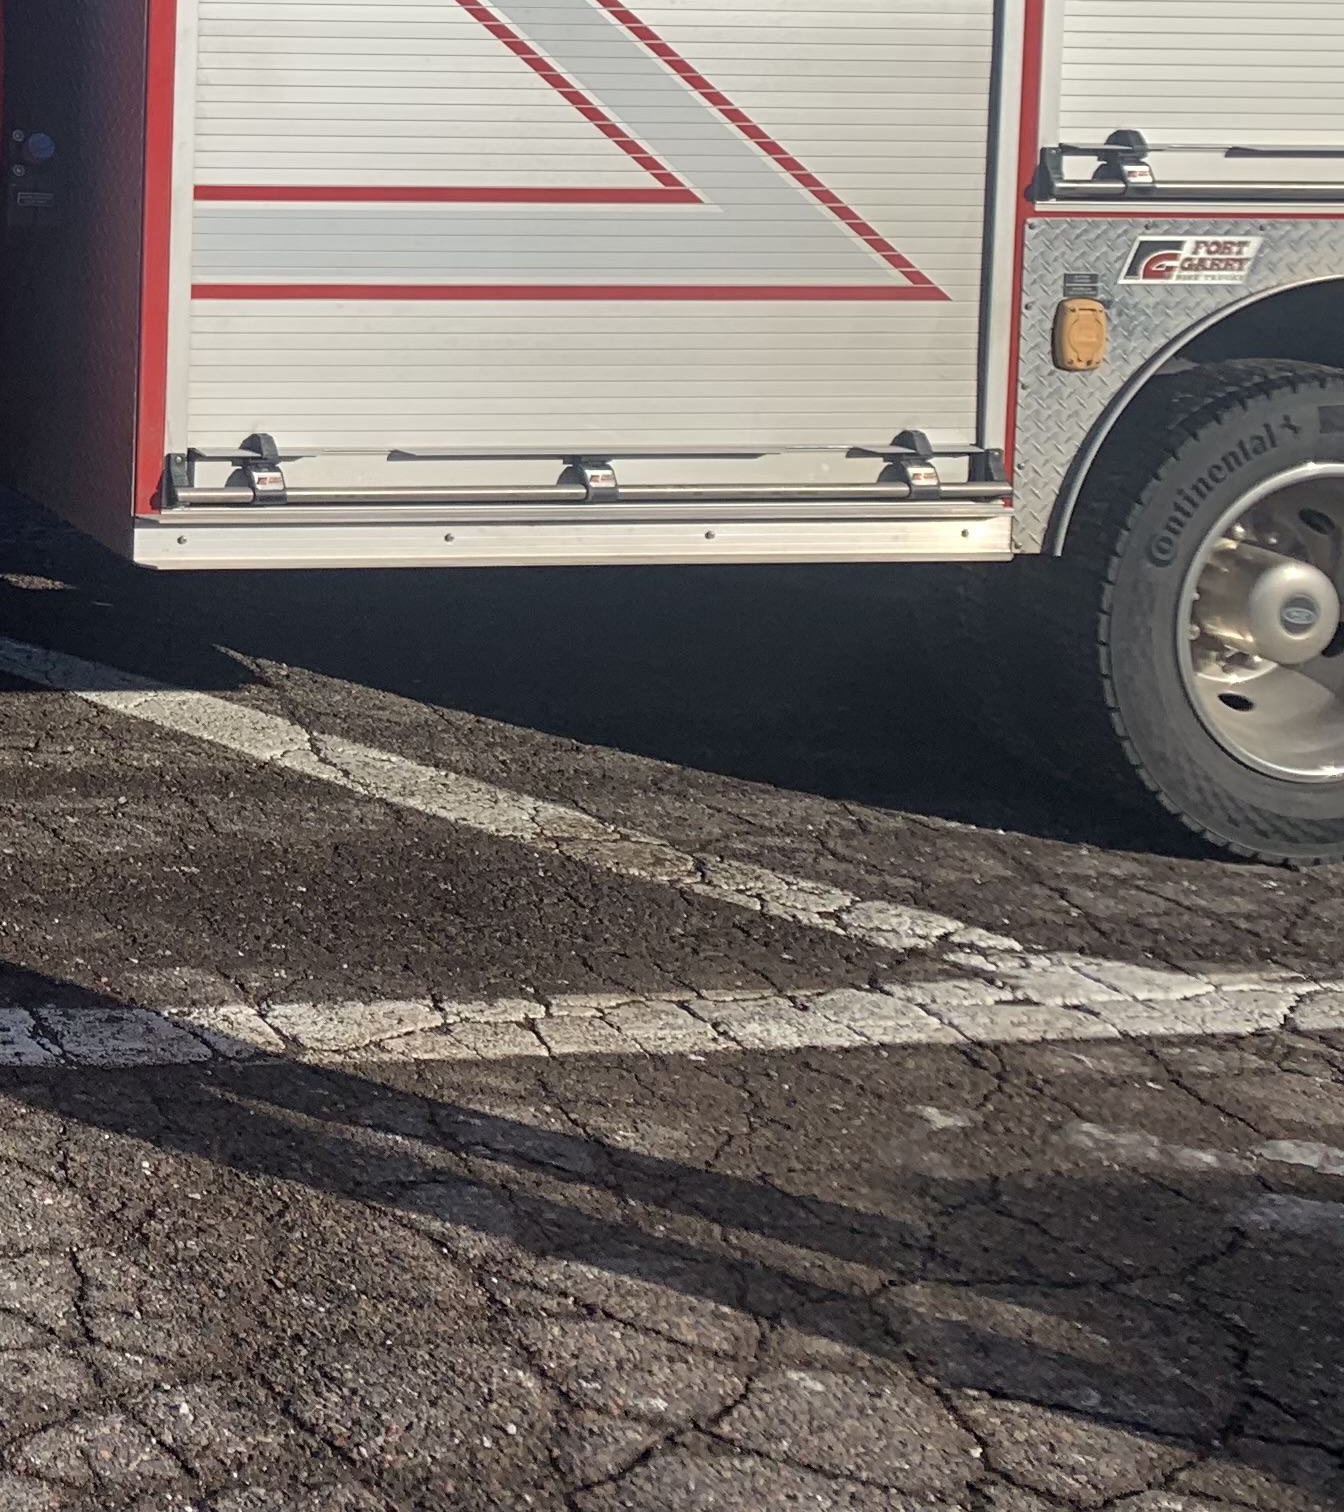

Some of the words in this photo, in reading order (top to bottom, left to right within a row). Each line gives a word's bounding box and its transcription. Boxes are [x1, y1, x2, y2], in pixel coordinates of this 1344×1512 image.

[1192, 240, 1252, 256] FORT
[1180, 257, 1251, 271] GARRY
[1146, 422, 1278, 569] Continental
